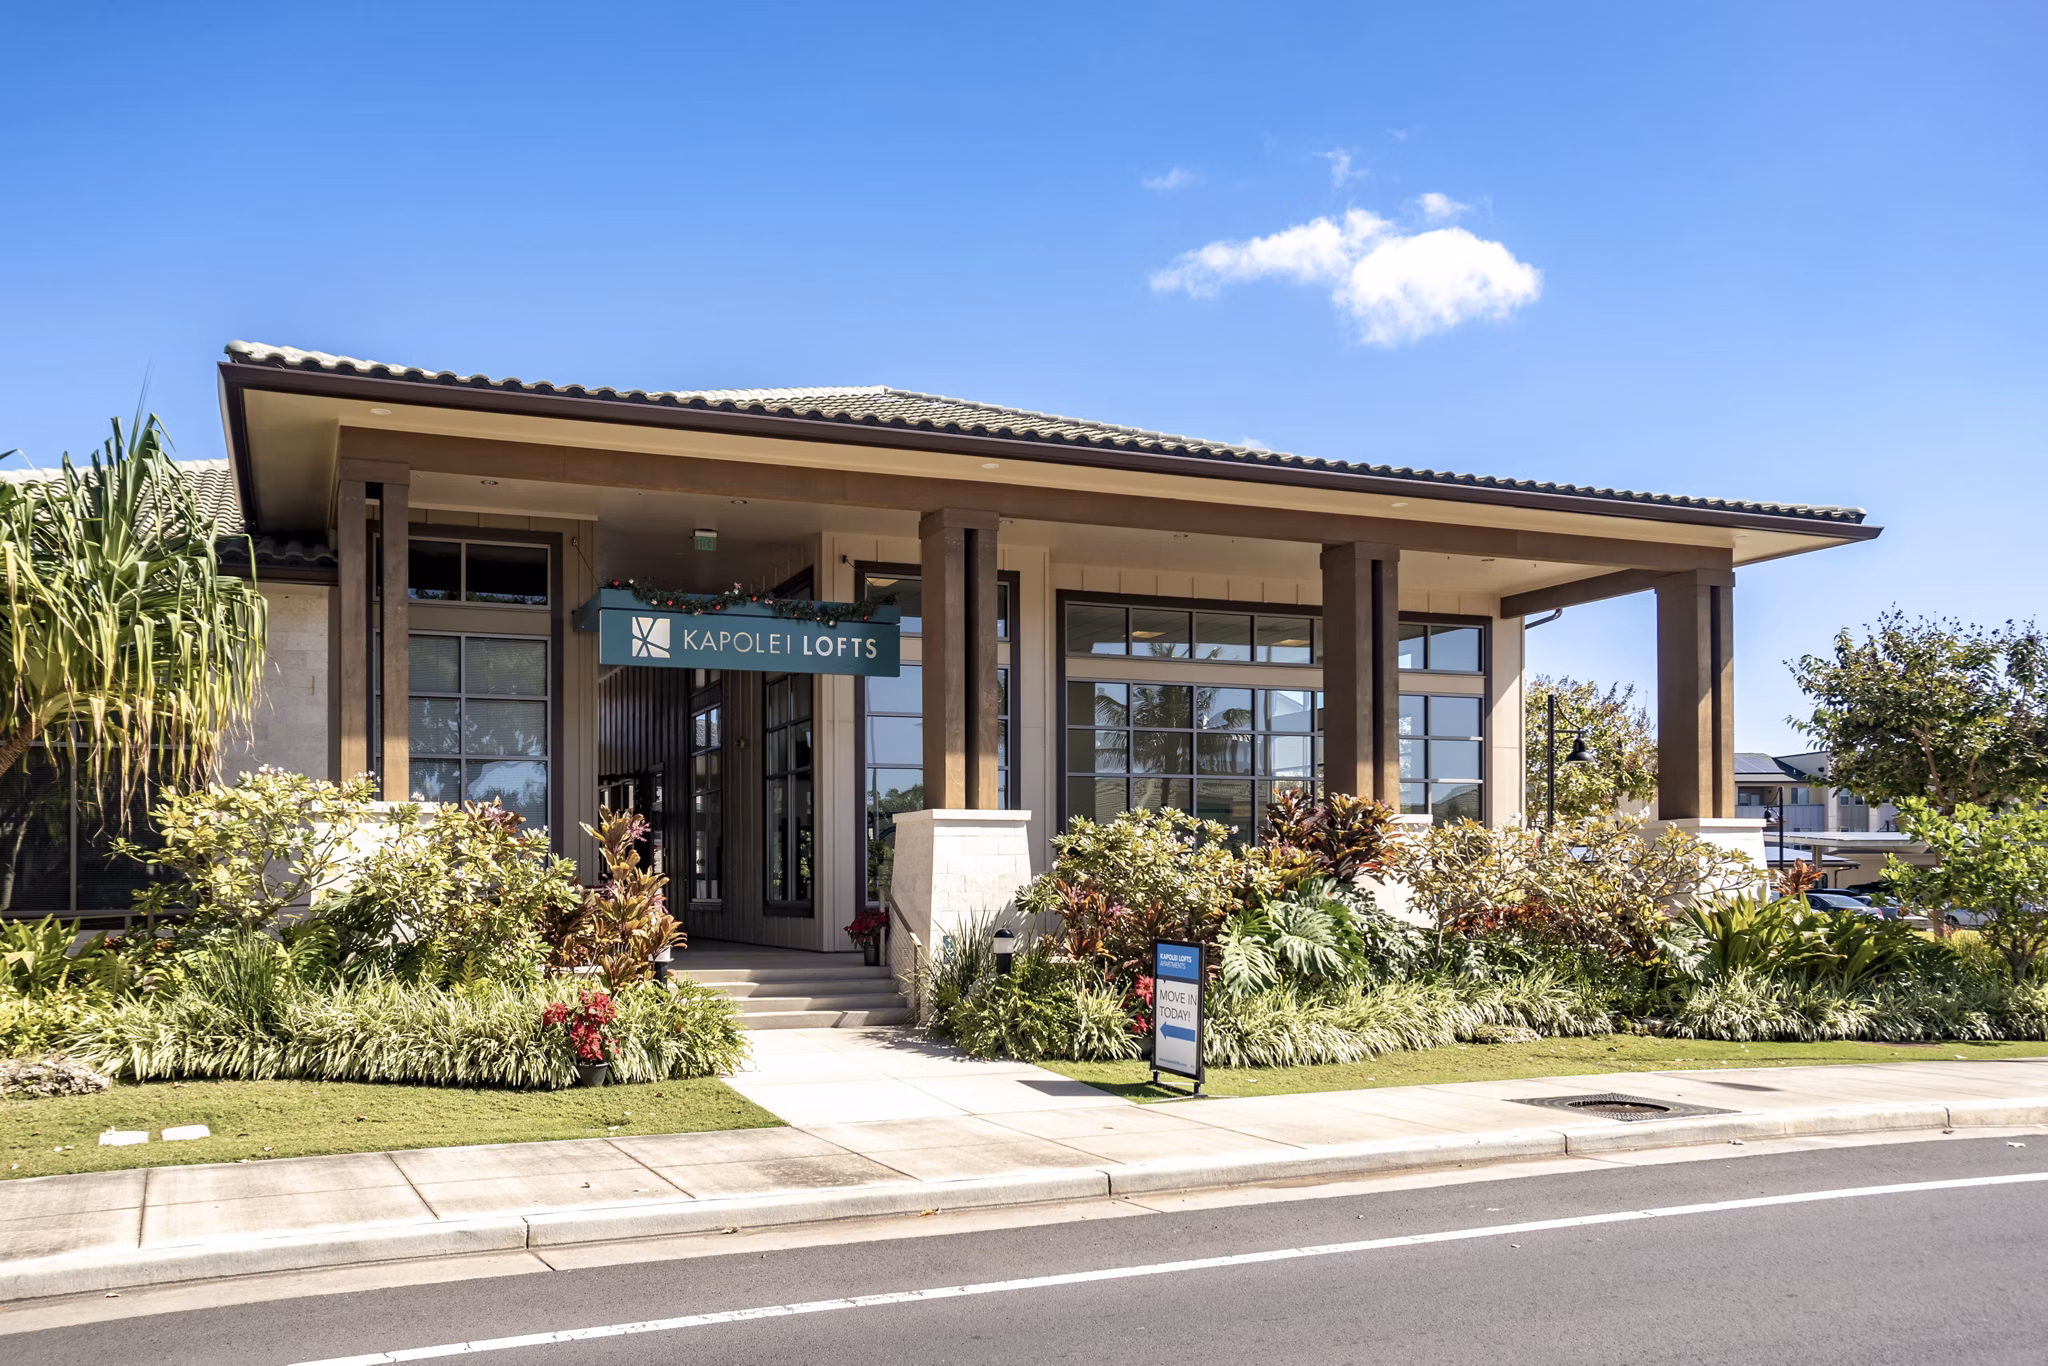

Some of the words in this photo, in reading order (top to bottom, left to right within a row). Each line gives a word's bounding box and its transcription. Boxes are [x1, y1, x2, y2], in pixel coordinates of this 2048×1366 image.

[684, 629, 791, 654] KAPOLEI
[804, 635, 877, 659] LOFTS
[1160, 953, 1178, 961] KAPOLEI
[1179, 955, 1192, 963] LOFTS
[1160, 960, 1186, 970] APARTMENTS
[1159, 989, 1185, 1004] MOVE
[1188, 993, 1197, 1006] IN
[1159, 1005, 1191, 1022] TODAY!
